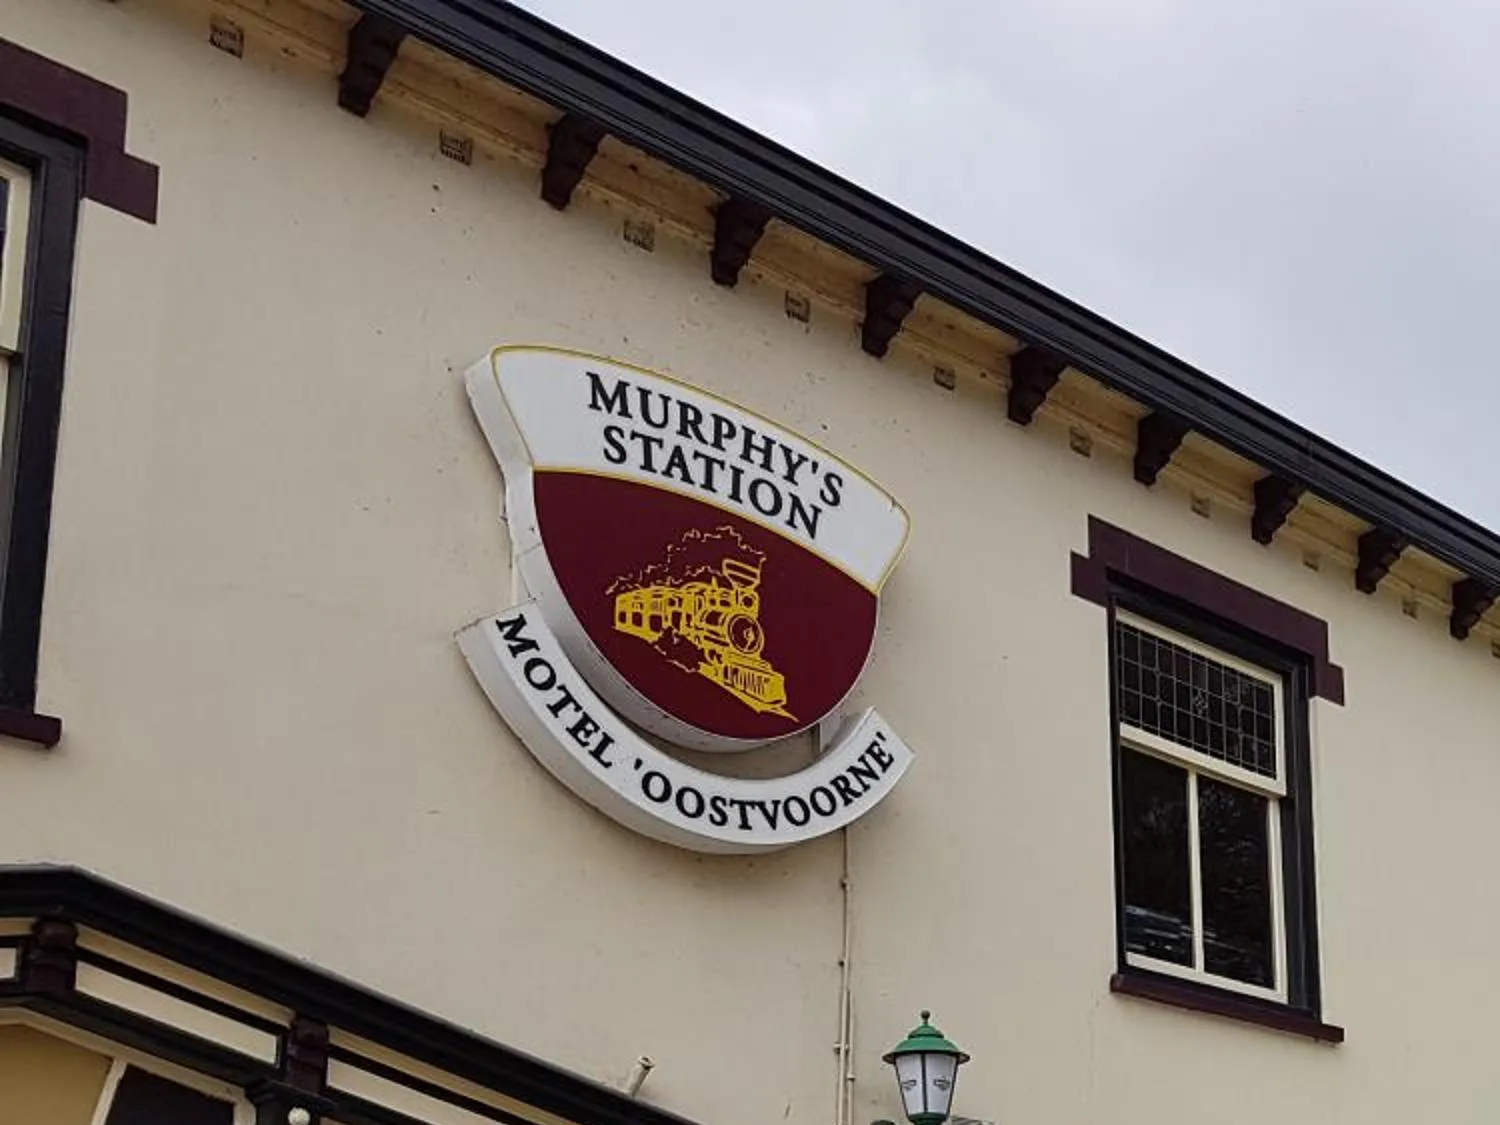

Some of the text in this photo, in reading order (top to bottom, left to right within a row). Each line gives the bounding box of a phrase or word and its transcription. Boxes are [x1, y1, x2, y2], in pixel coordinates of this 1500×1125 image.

[586, 371, 843, 508] MURPHY'S
[603, 425, 822, 540] STATION
[495, 614, 895, 831] MOTEL 'OOSTVOORNE'
